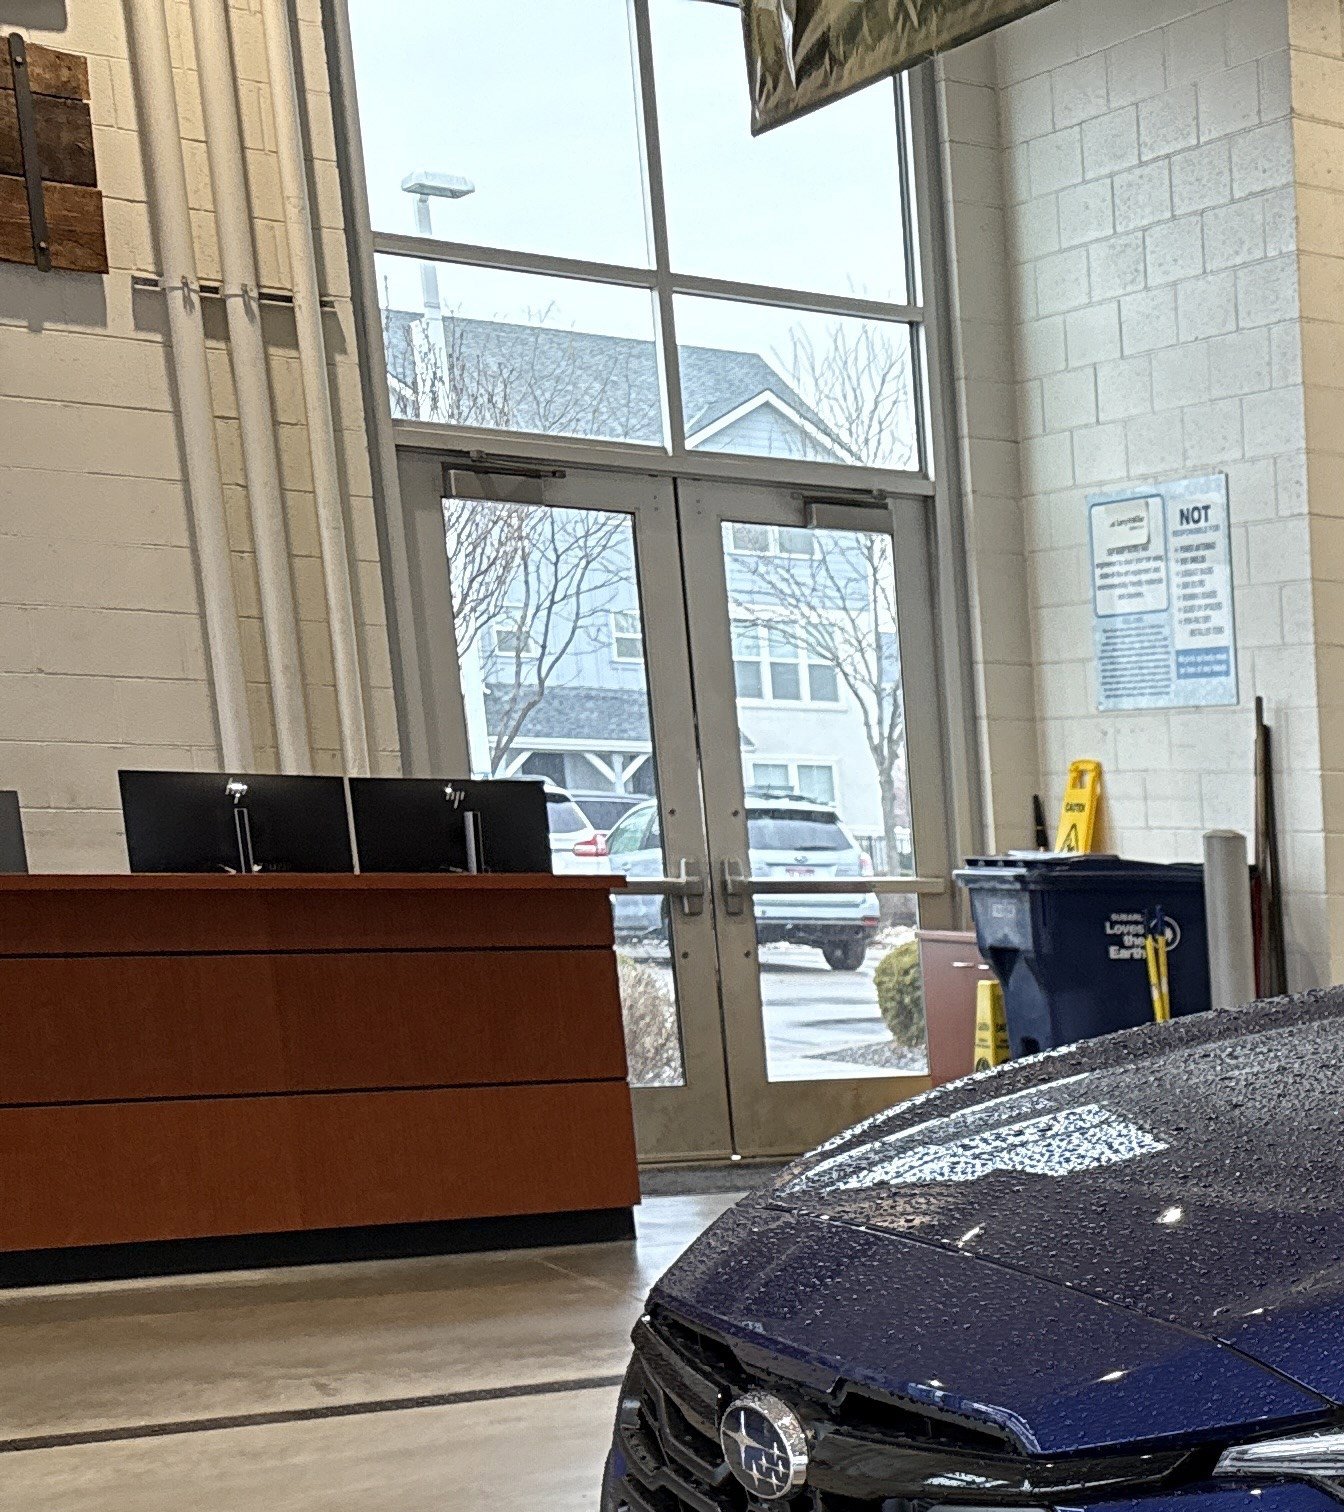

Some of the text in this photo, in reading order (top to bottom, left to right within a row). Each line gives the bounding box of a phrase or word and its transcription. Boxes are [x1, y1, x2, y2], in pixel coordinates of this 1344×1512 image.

[1179, 504, 1211, 526] NOT
[1105, 921, 1145, 935] Loves
[1122, 934, 1146, 947] the
[1109, 945, 1148, 960] Earth
